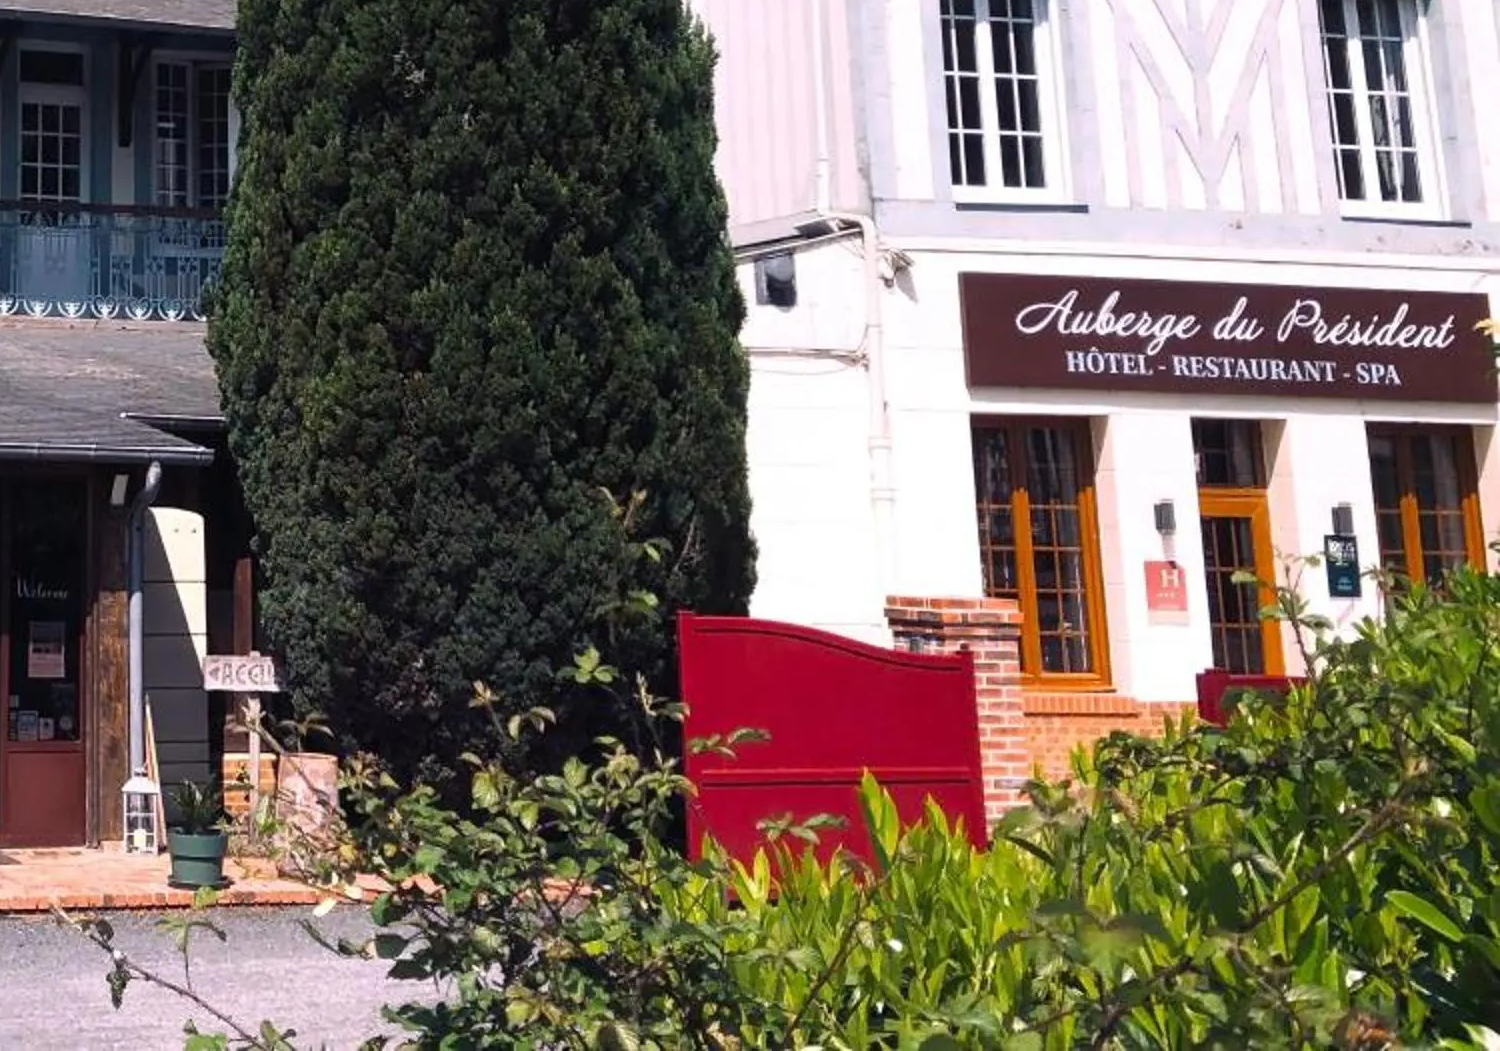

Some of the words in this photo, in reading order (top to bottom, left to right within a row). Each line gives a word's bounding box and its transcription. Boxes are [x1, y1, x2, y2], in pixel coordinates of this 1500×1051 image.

[1015, 290, 1202, 354] Auberge
[1213, 297, 1264, 342] du
[1278, 299, 1456, 351] Président
[1066, 347, 1153, 377] HÔTEL
[1173, 356, 1337, 383] RESTAURANT
[1356, 368, 1402, 386] SPA
[1161, 569, 1179, 588] H
